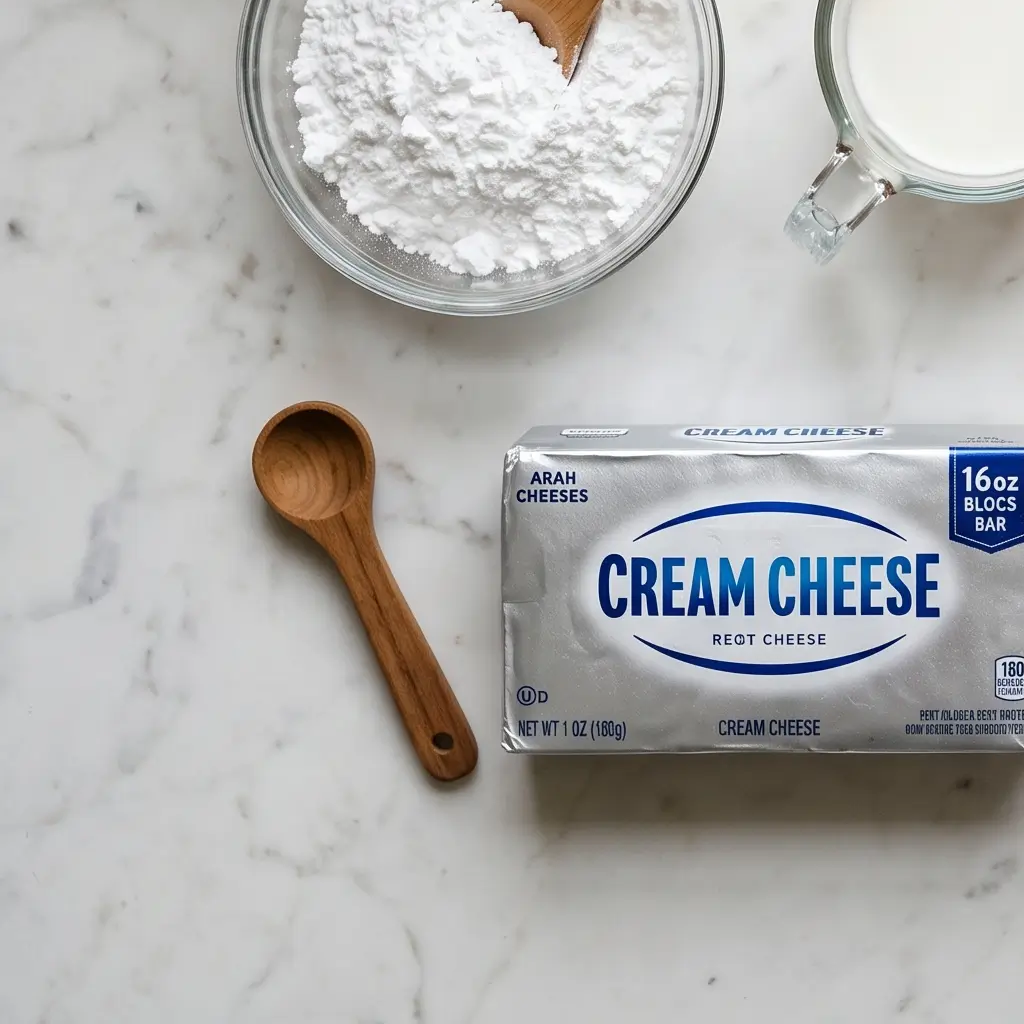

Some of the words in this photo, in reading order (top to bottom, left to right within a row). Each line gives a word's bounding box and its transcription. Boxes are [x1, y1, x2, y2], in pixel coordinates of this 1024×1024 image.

[684, 428, 778, 436] CREAM
[530, 471, 576, 485] ARAH
[516, 489, 589, 503] CHEESES
[964, 496, 1017, 512] BLOCS
[975, 516, 1007, 532] BAR
[598, 553, 755, 618] CREAM
[768, 553, 940, 618] CHEESE
[763, 633, 826, 646] CHEESE
[1001, 661, 1024, 677] 180
[518, 720, 539, 737] NET
[541, 720, 560, 737] WT
[562, 720, 568, 737] 1
[571, 720, 587, 737] OZ
[718, 719, 765, 736] CREAM
[769, 719, 821, 736] CHEESE
